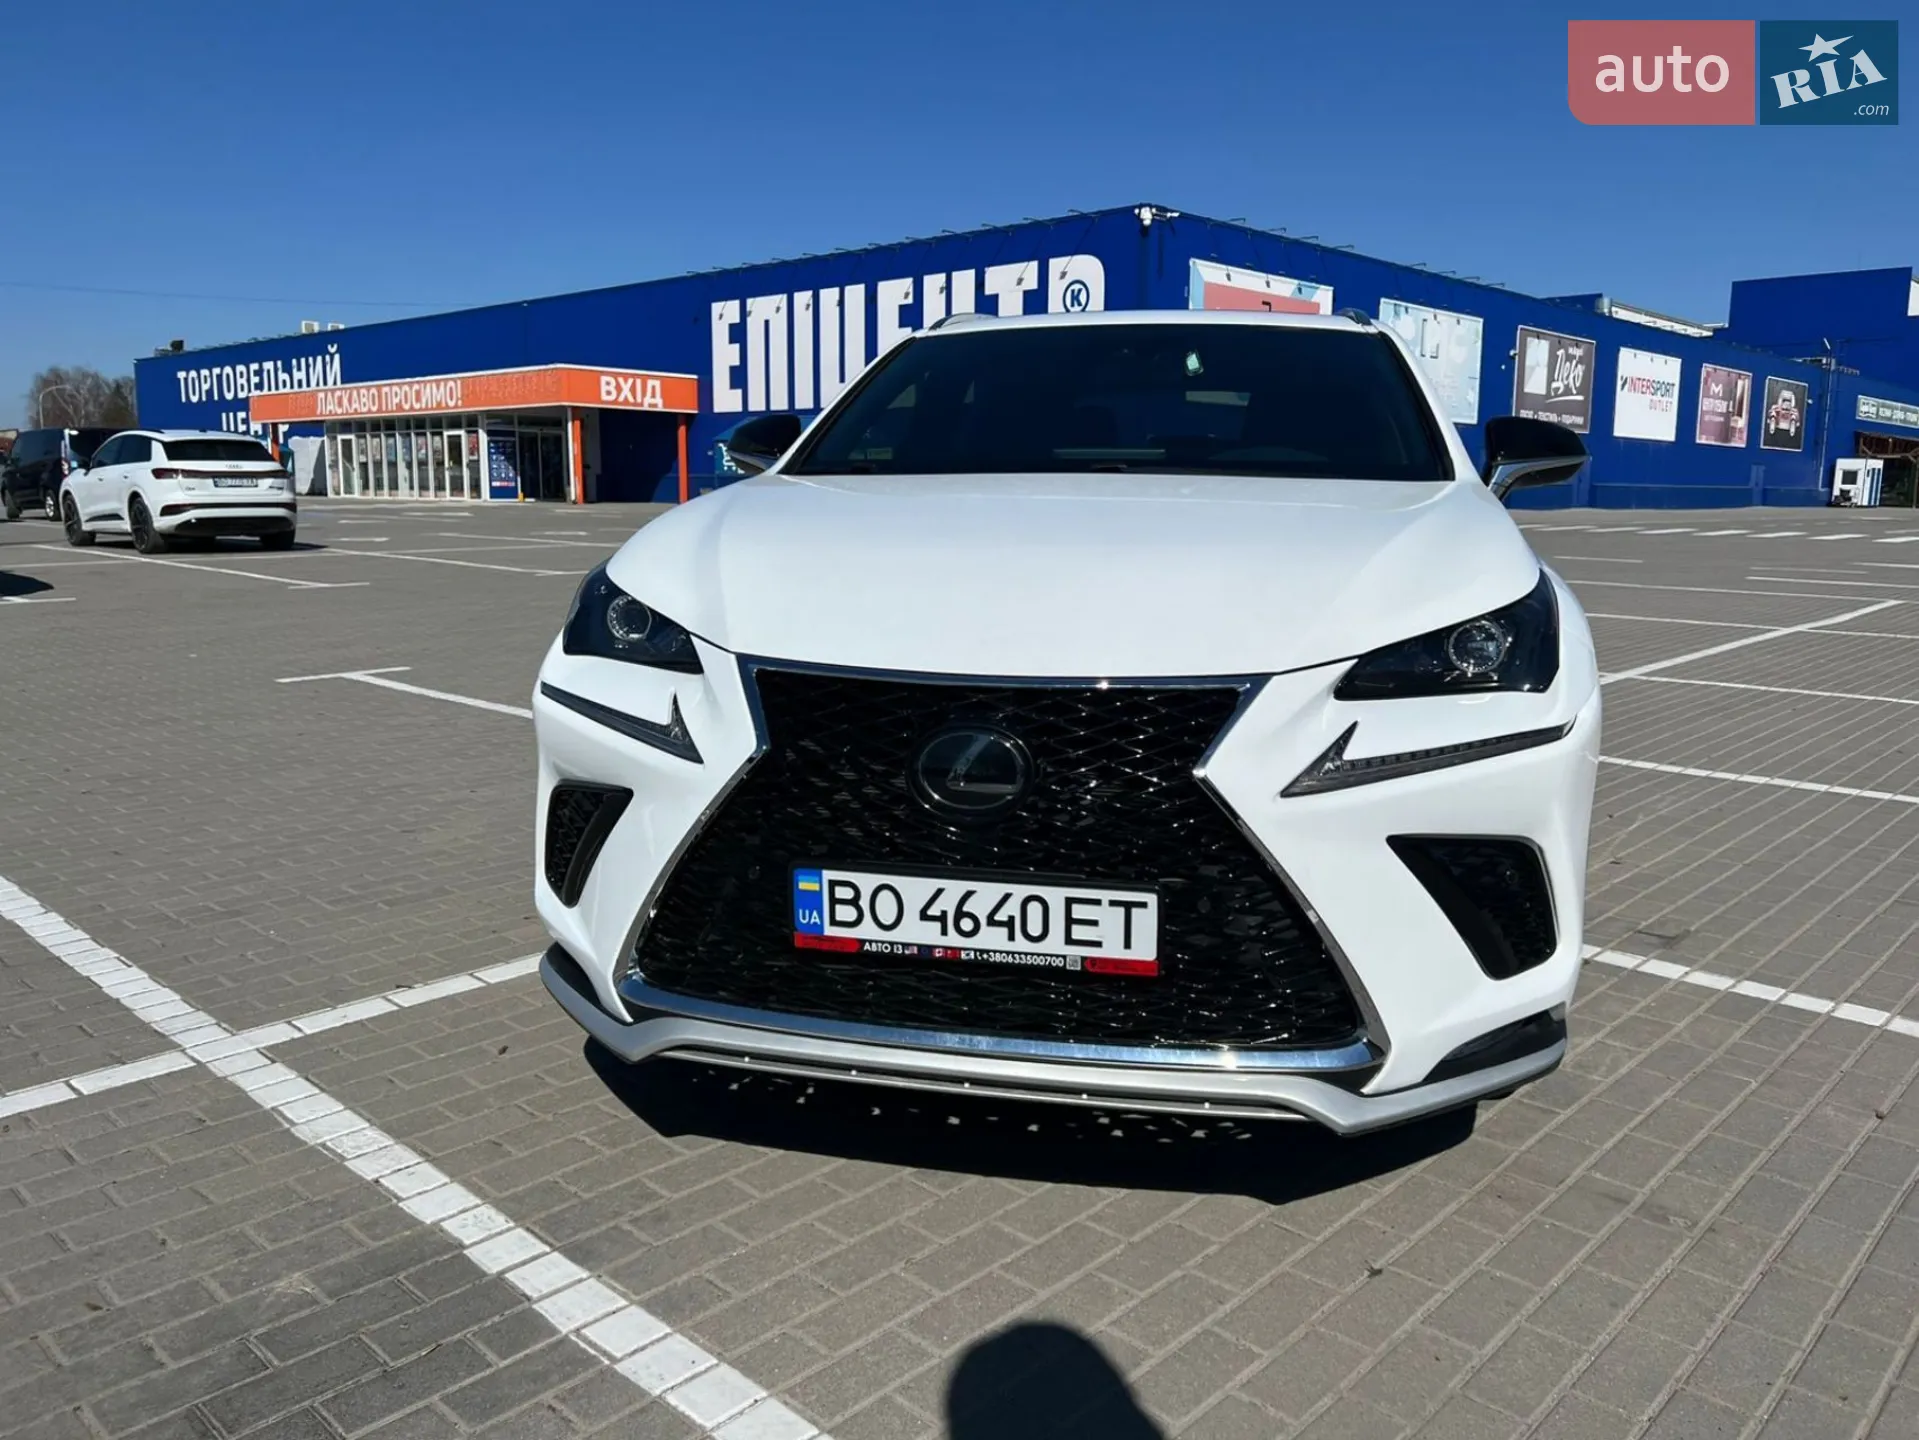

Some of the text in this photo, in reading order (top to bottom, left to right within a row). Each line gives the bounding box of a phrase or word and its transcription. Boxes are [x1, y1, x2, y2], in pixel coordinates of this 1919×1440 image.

[176, 343, 342, 403] ТОРГОВЕЛЬНИЙ
[1628, 376, 1676, 399] INTERSPORT
[316, 388, 378, 415] ЛАСКАВО
[382, 379, 463, 412] ПРОСИМО!
[600, 375, 664, 409] ВХІД
[1649, 399, 1673, 412] OUTLET
[799, 908, 821, 925] UA
[827, 878, 1149, 950] BO 4640 ET
[863, 941, 891, 954] АВТО
[982, 951, 1065, 967] +380633500700
